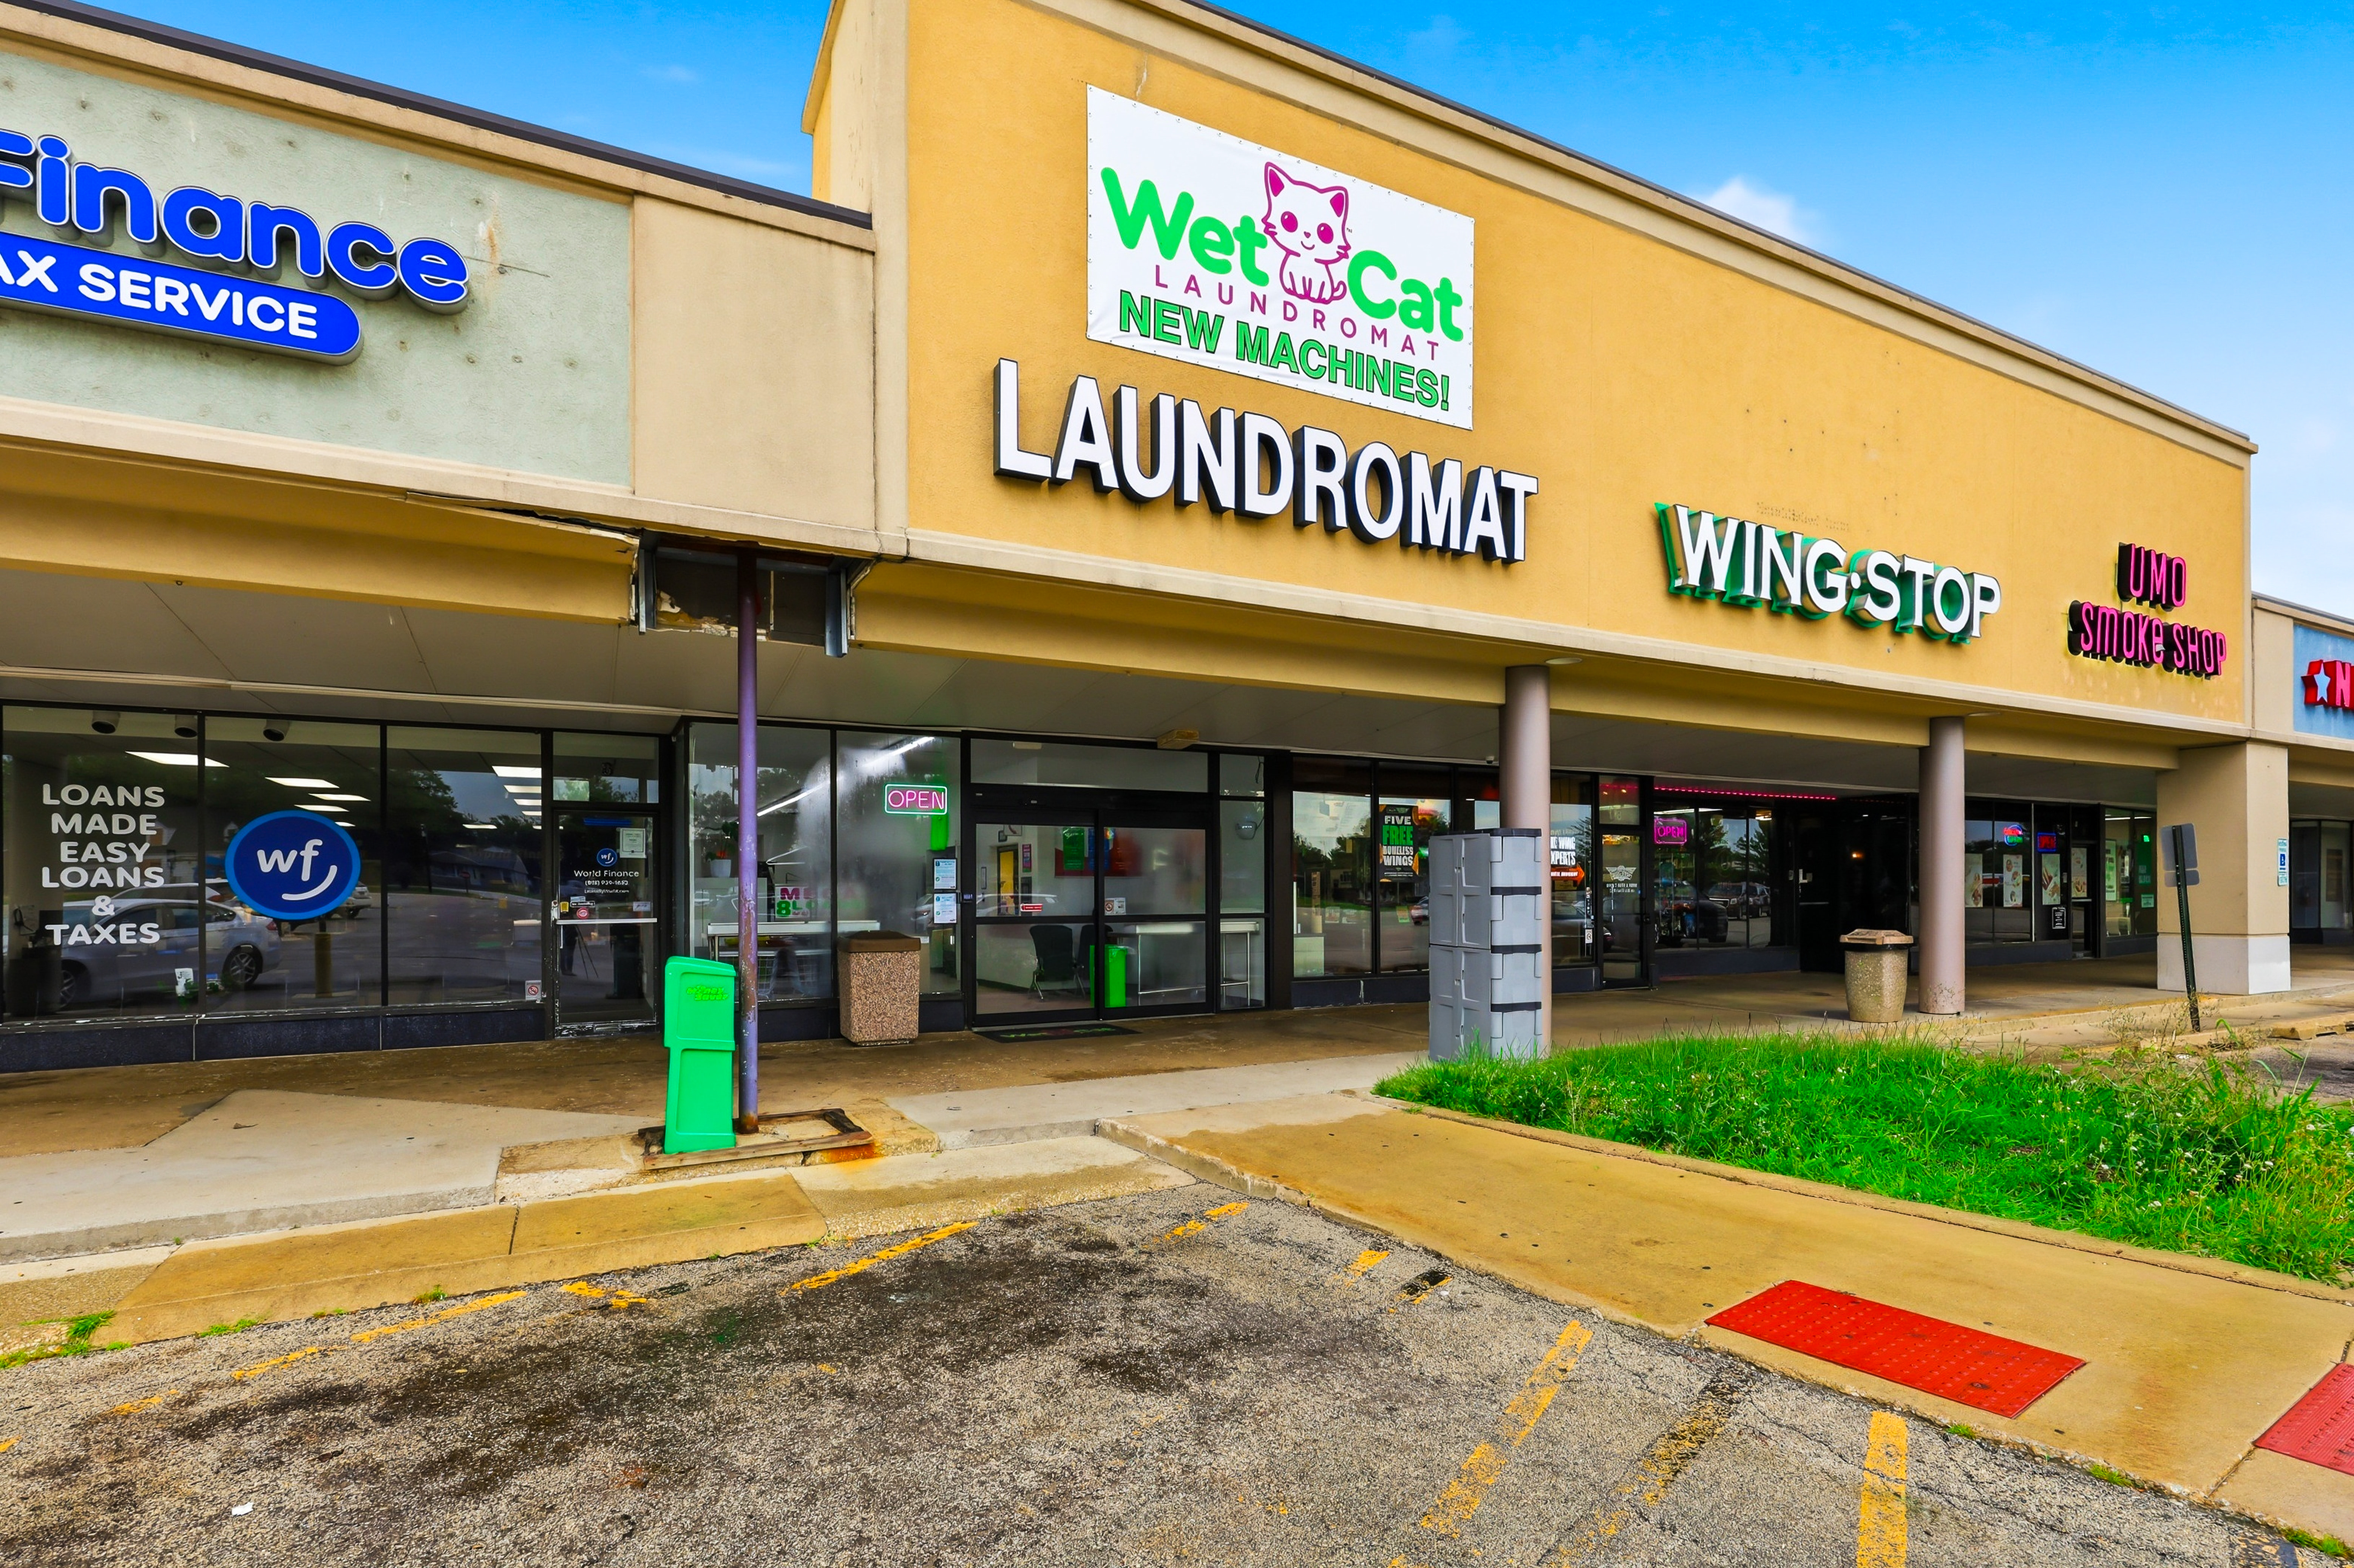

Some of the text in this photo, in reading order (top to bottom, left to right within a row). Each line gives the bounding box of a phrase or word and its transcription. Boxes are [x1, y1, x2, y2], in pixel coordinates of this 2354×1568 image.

[1101, 167, 1463, 342] Wet Cat
[78, 263, 318, 340] SERVICE
[1155, 265, 1439, 360] LAUNDROMAT
[1119, 290, 1449, 411] NEW MACHINES!
[996, 358, 1538, 563] LAUNDROMAT
[2128, 543, 2187, 608] UMO
[2172, 623, 2227, 676] SHOP
[43, 784, 165, 807] LOANS
[888, 790, 944, 810] OPEN
[51, 813, 157, 835] MADE
[1385, 815, 1411, 825] FIVE
[1382, 825, 1413, 846] FREE
[1657, 826, 1684, 838] OPEN
[60, 841, 150, 863] EASY
[257, 839, 323, 881] wf
[1383, 855, 1413, 866] WINGS
[1551, 850, 1576, 866] XPERTS
[42, 867, 165, 888] LOANS
[92, 895, 115, 917] &
[45, 923, 160, 946] TAXES
